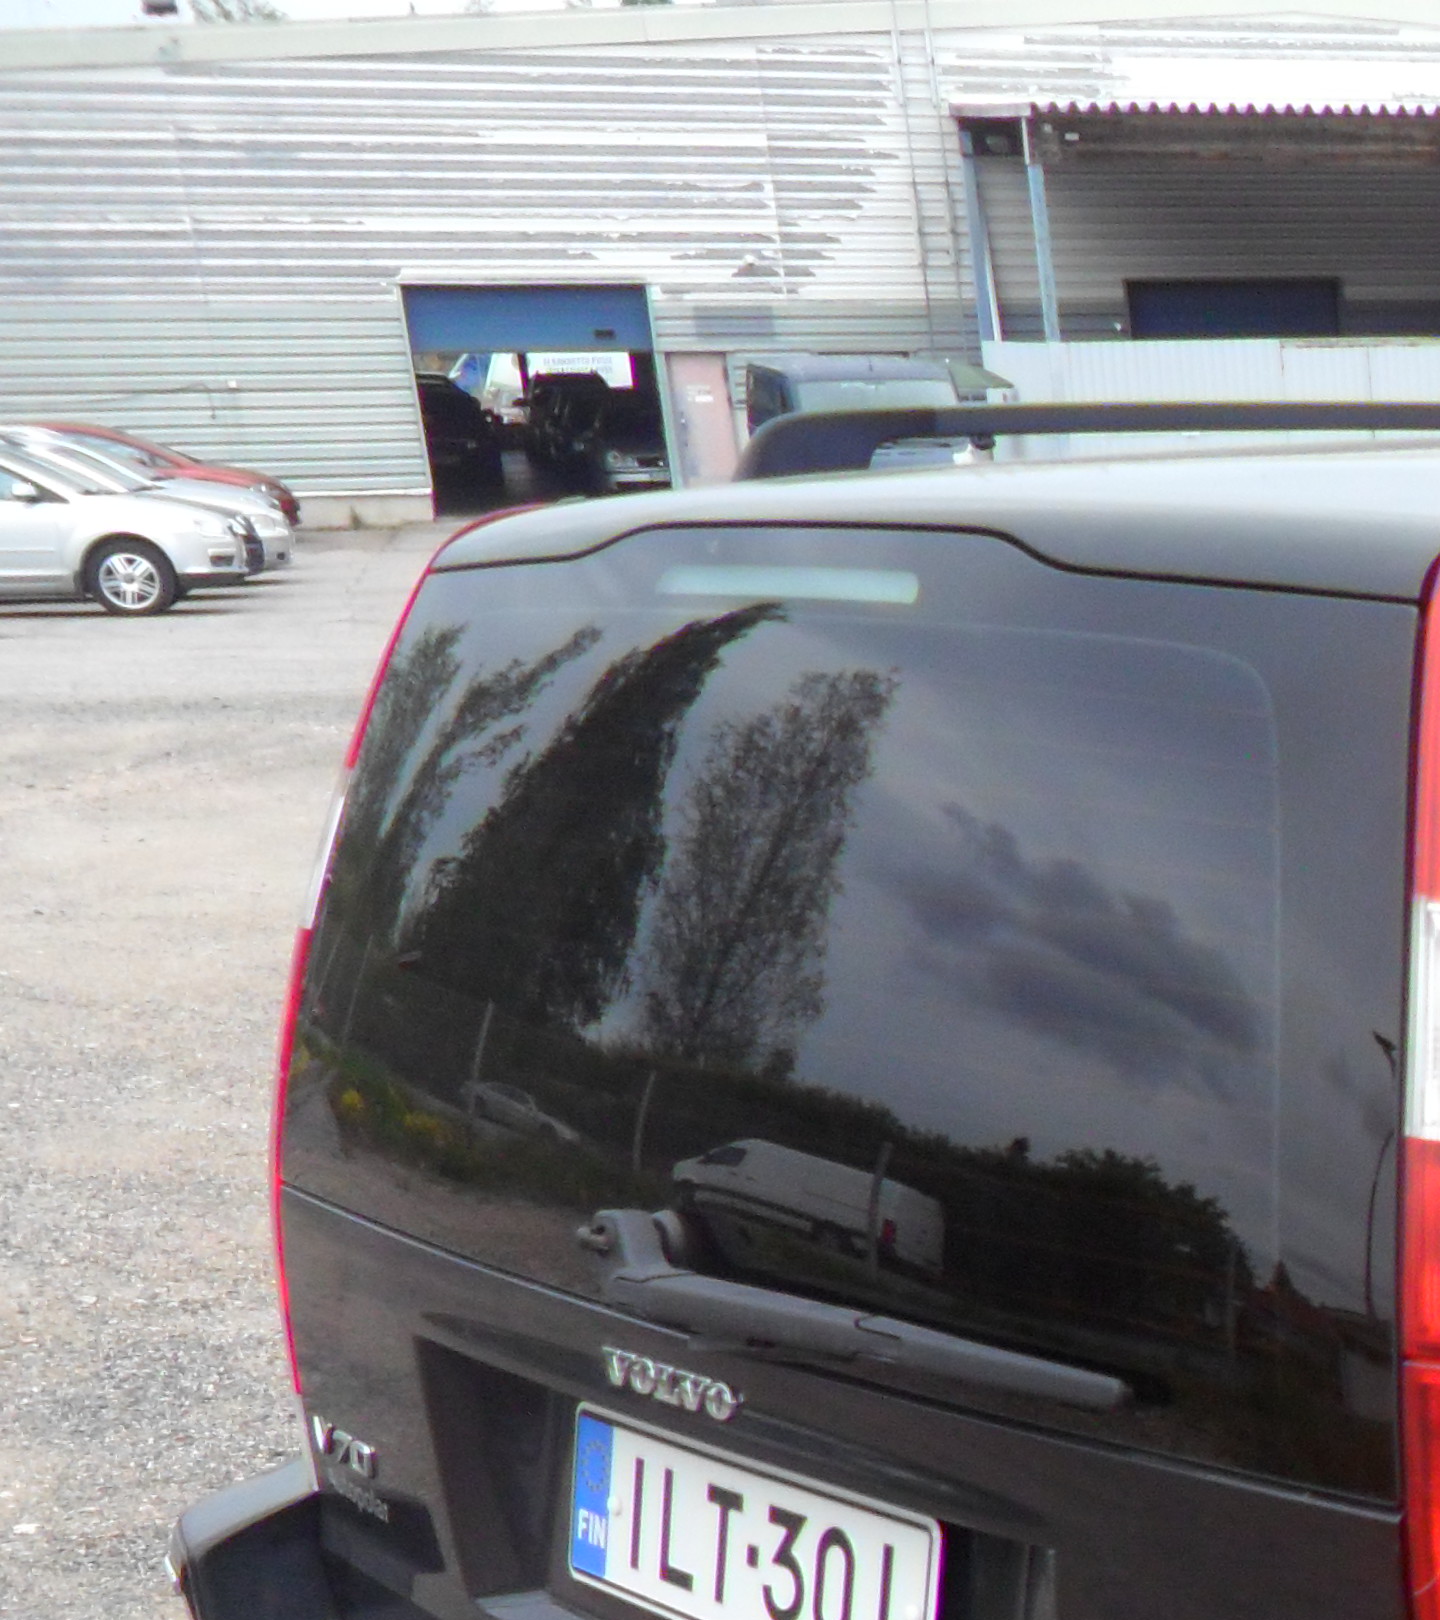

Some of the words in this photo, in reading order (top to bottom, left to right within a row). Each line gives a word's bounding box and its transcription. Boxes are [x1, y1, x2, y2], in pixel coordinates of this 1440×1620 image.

[601, 1346, 737, 1421] VOLVO
[312, 1415, 372, 1478] V70
[577, 1508, 607, 1549] FIN
